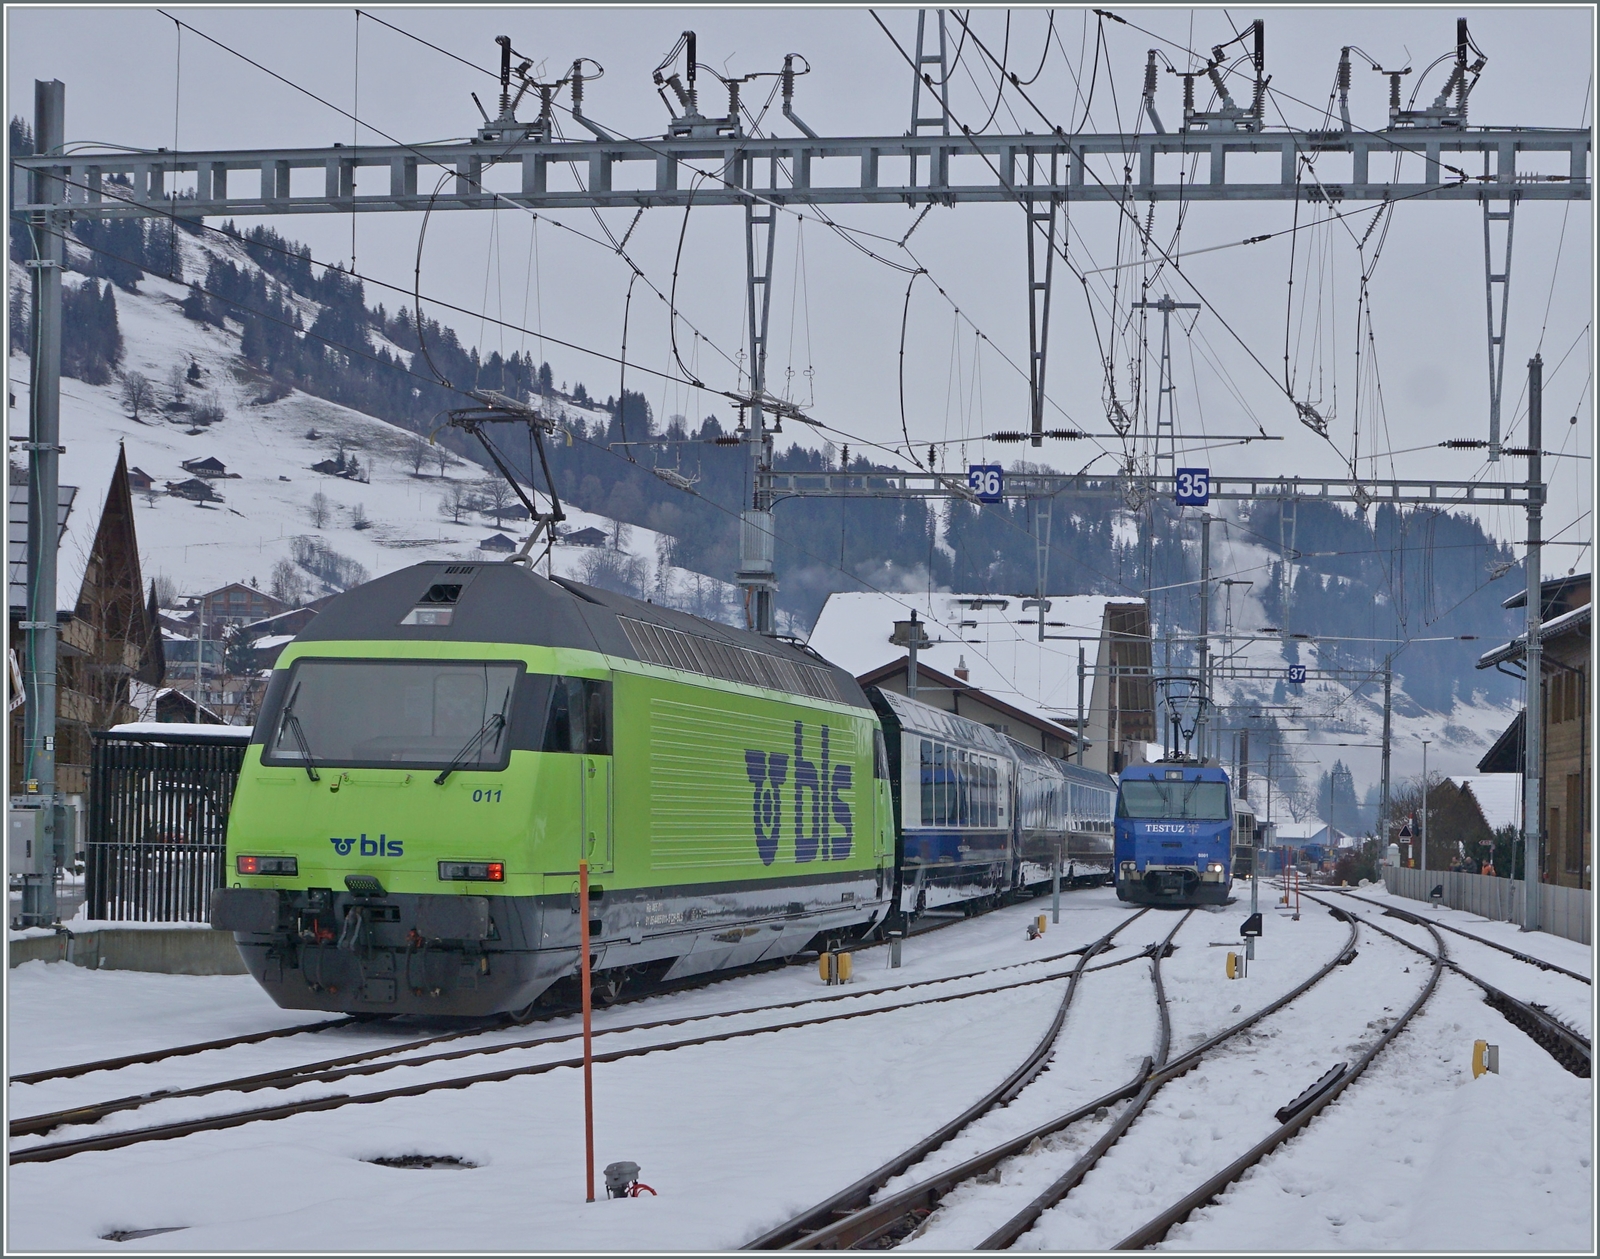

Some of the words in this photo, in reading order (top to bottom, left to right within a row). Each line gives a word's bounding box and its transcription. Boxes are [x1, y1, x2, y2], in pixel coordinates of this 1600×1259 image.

[970, 470, 1000, 495] 36
[1178, 473, 1208, 498] 35
[1290, 667, 1305, 680] 37
[472, 789, 502, 803] 011
[794, 720, 854, 864] bls
[1145, 824, 1185, 833] TESTUZ
[360, 833, 404, 857] bls
